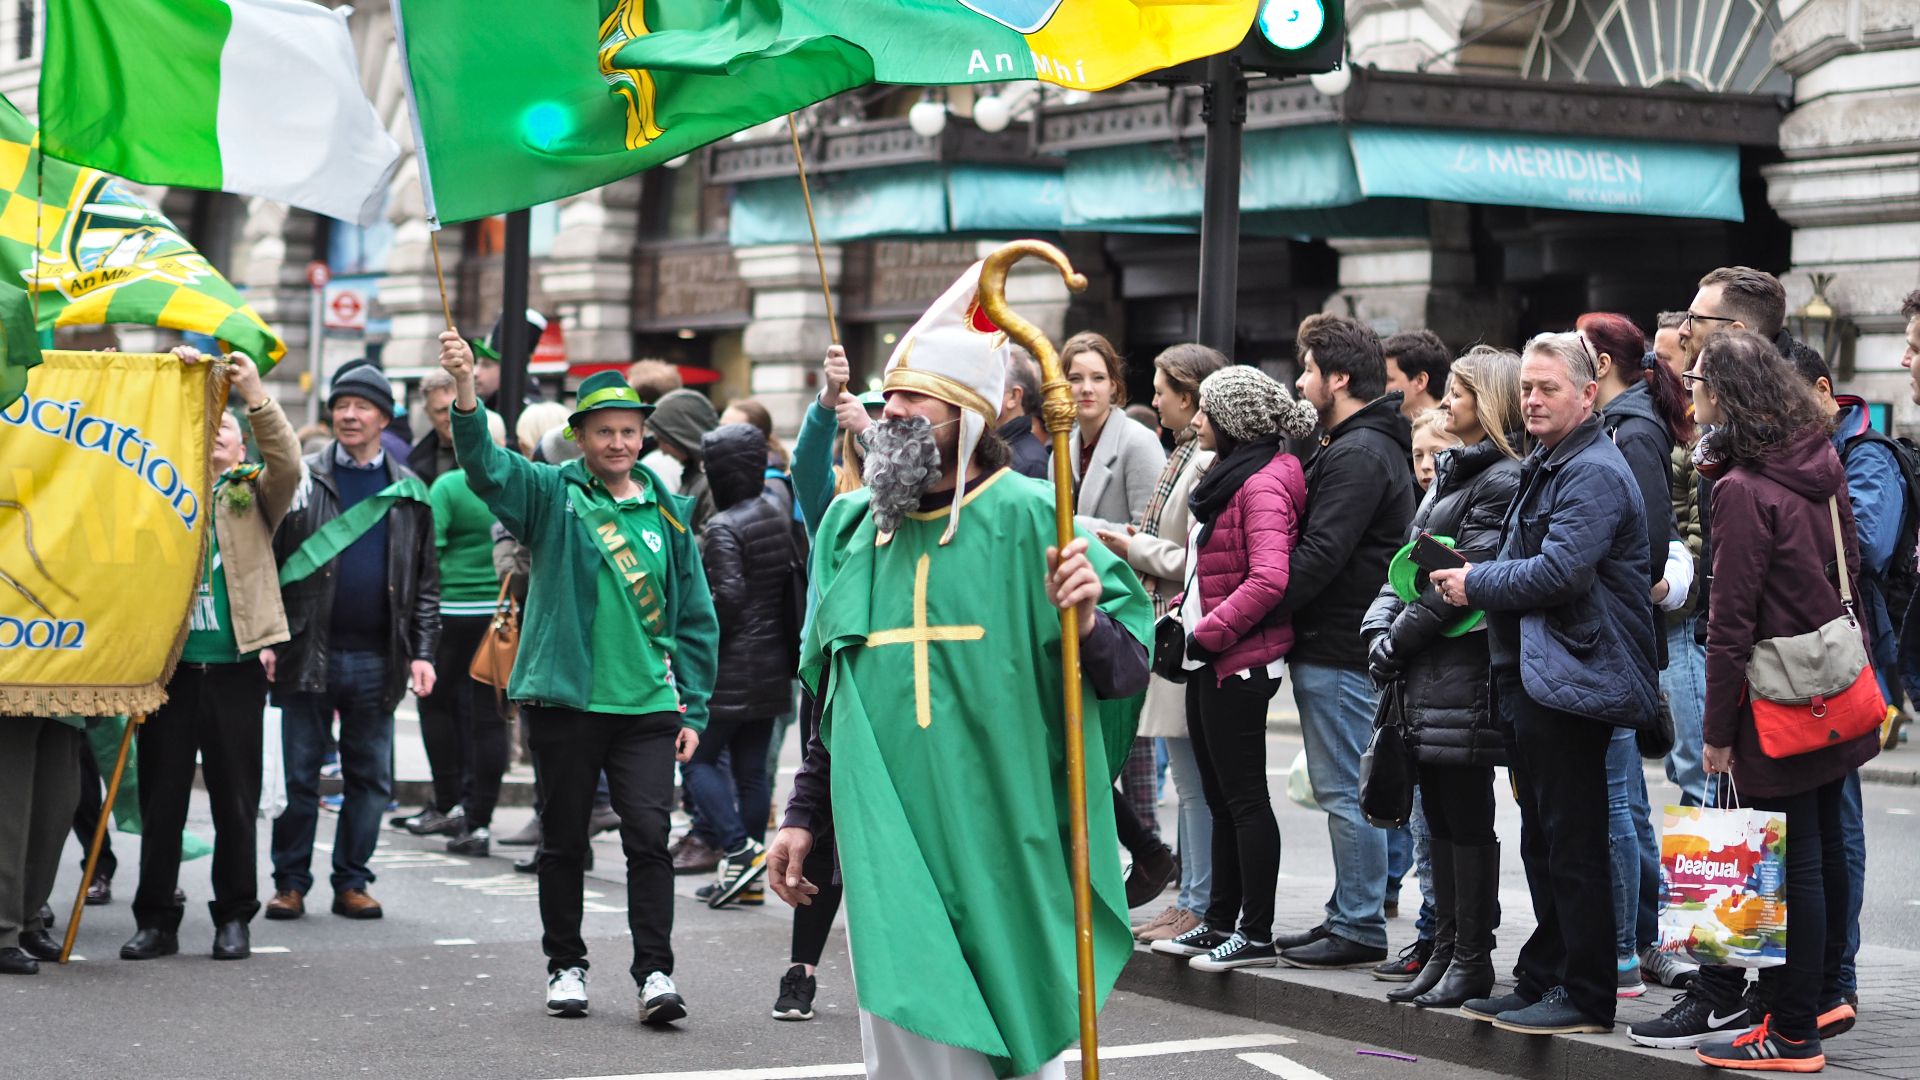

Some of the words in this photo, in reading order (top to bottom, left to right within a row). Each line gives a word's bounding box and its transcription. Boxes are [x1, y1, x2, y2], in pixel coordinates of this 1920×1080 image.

[967, 49, 1014, 75] An
[1030, 50, 1086, 84] Mhí
[1487, 145, 1643, 184] MERIDIEN
[71, 277, 97, 294] An
[1674, 853, 1739, 881] Desigual
